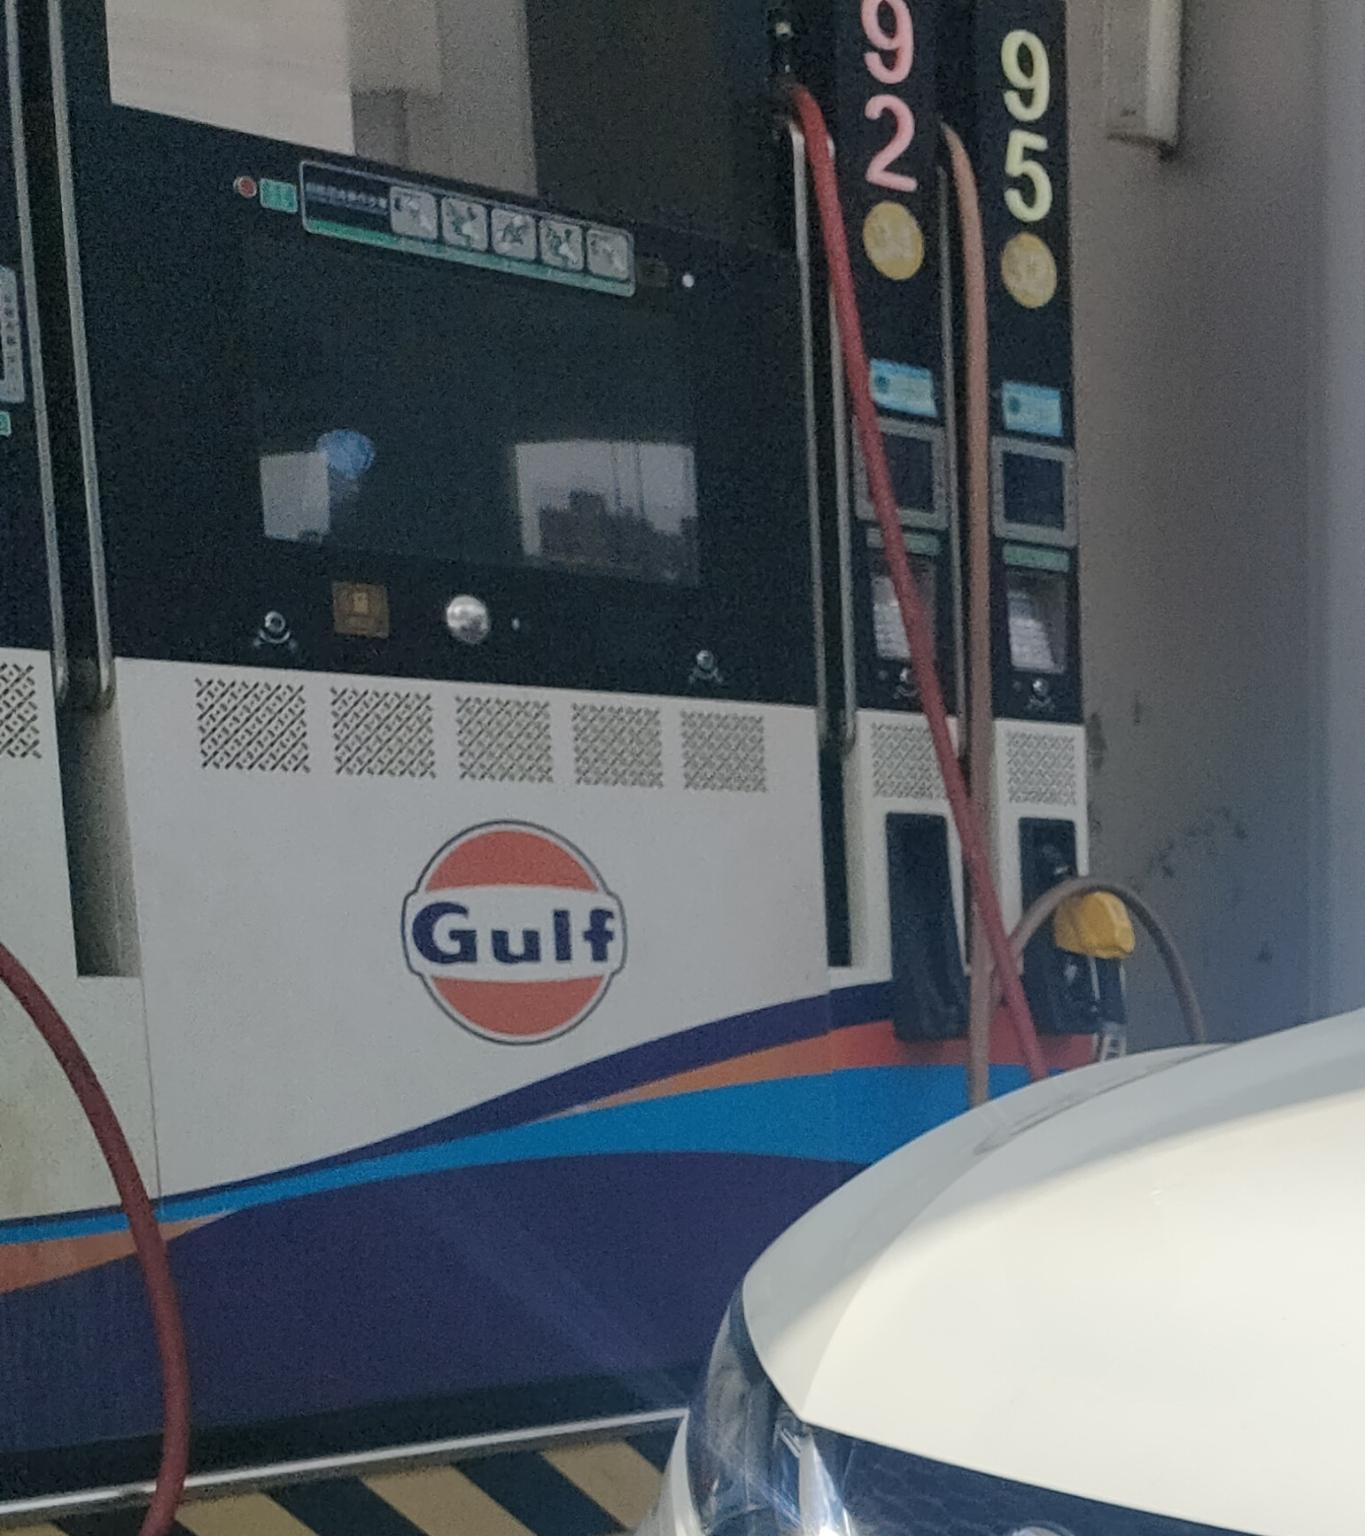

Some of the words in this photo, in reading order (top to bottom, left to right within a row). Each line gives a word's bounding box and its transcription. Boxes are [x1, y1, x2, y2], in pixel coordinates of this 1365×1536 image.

[861, 0, 917, 192] 92
[1001, 29, 1053, 223] 95
[411, 901, 616, 965] Gulf
